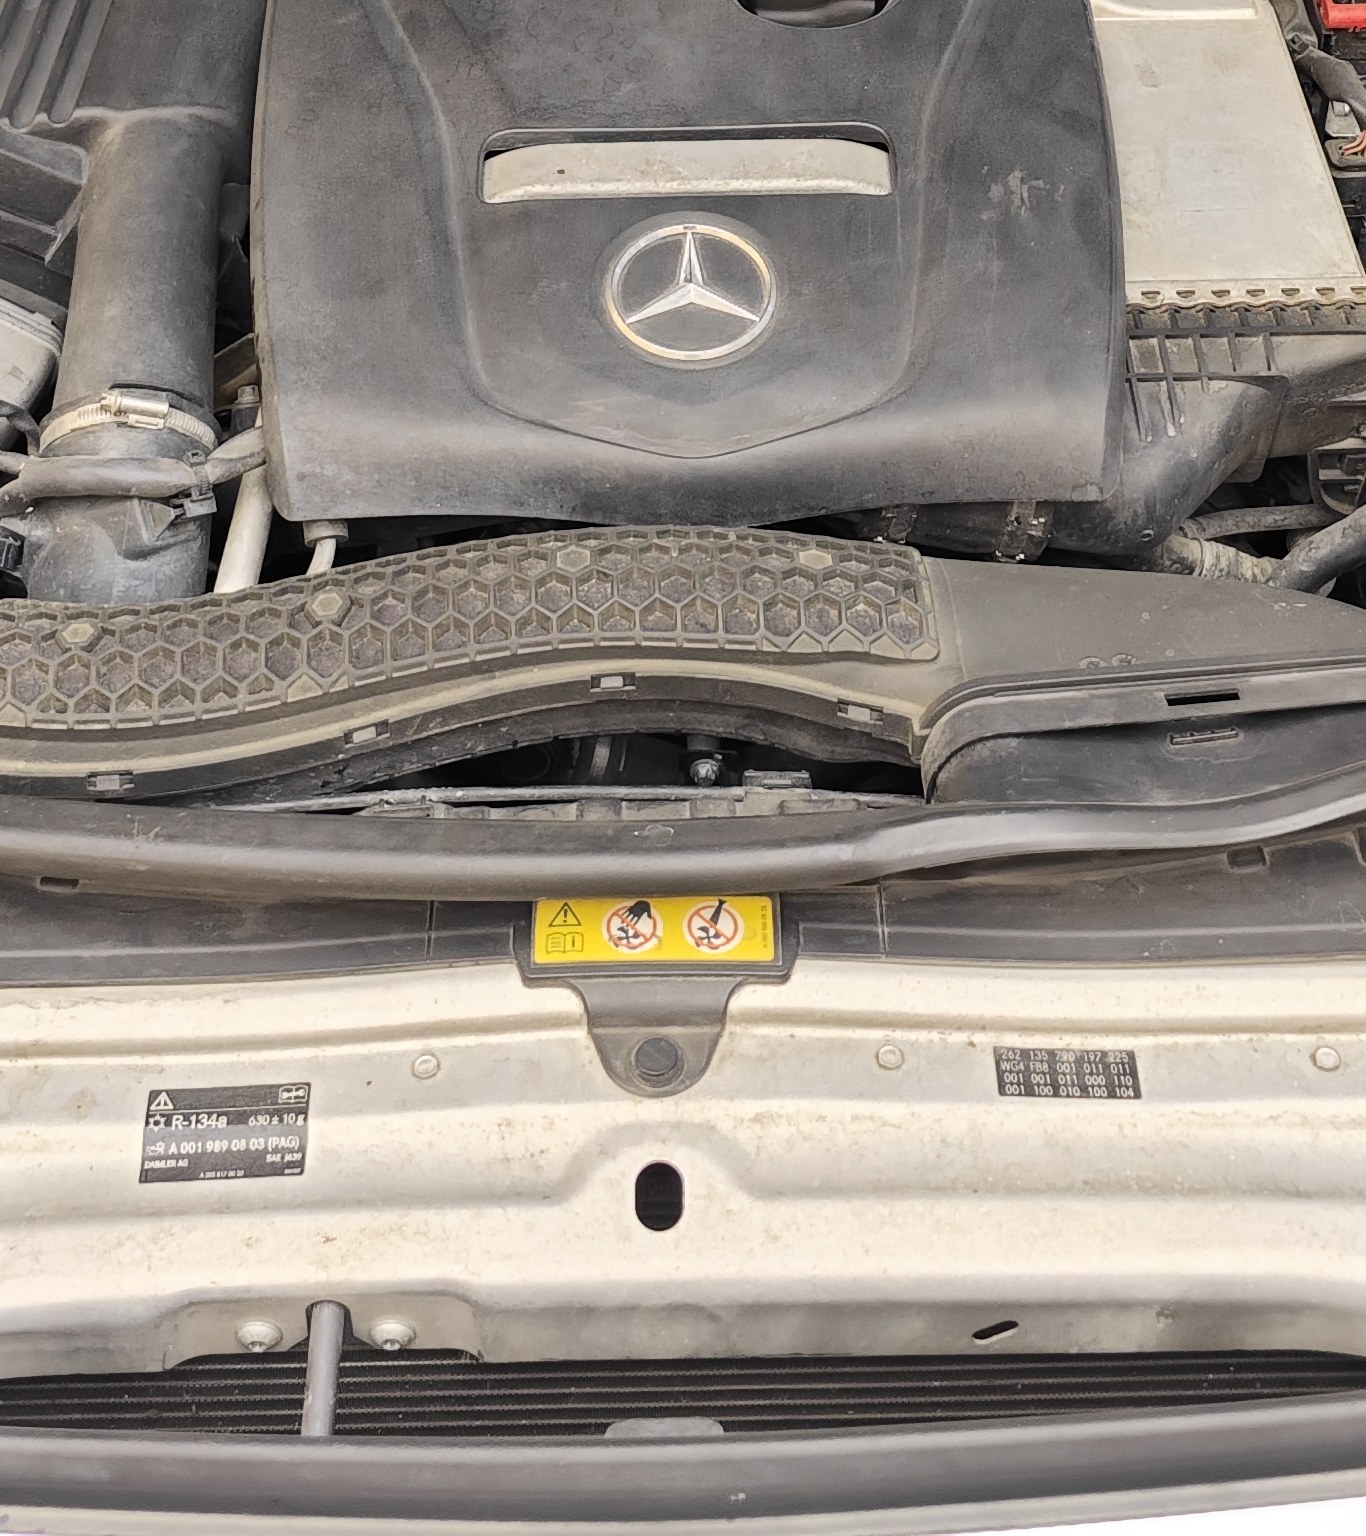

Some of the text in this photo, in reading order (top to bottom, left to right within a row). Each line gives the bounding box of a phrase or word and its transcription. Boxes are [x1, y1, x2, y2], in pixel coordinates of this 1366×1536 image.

[1000, 1048, 1022, 1060] 262
[1029, 1049, 1049, 1061] 135
[1083, 1051, 1102, 1062] 197
[999, 1059, 1024, 1072] WG4
[1056, 1062, 1077, 1074] 001
[1083, 1062, 1104, 1074] 011
[1110, 1063, 1130, 1074] 011
[1004, 1072, 1133, 1086] 001 001 011 000 110
[1005, 1083, 1135, 1098] 001 100 010 100 104
[171, 1112, 228, 1131] R-134a
[248, 1113, 271, 1127] 630
[283, 1112, 296, 1125] 10
[168, 1141, 178, 1155] A
[180, 1141, 203, 1154] 001
[206, 1139, 229, 1153] 989
[249, 1137, 266, 1151] 03
[267, 1135, 300, 1152] (PAG)
